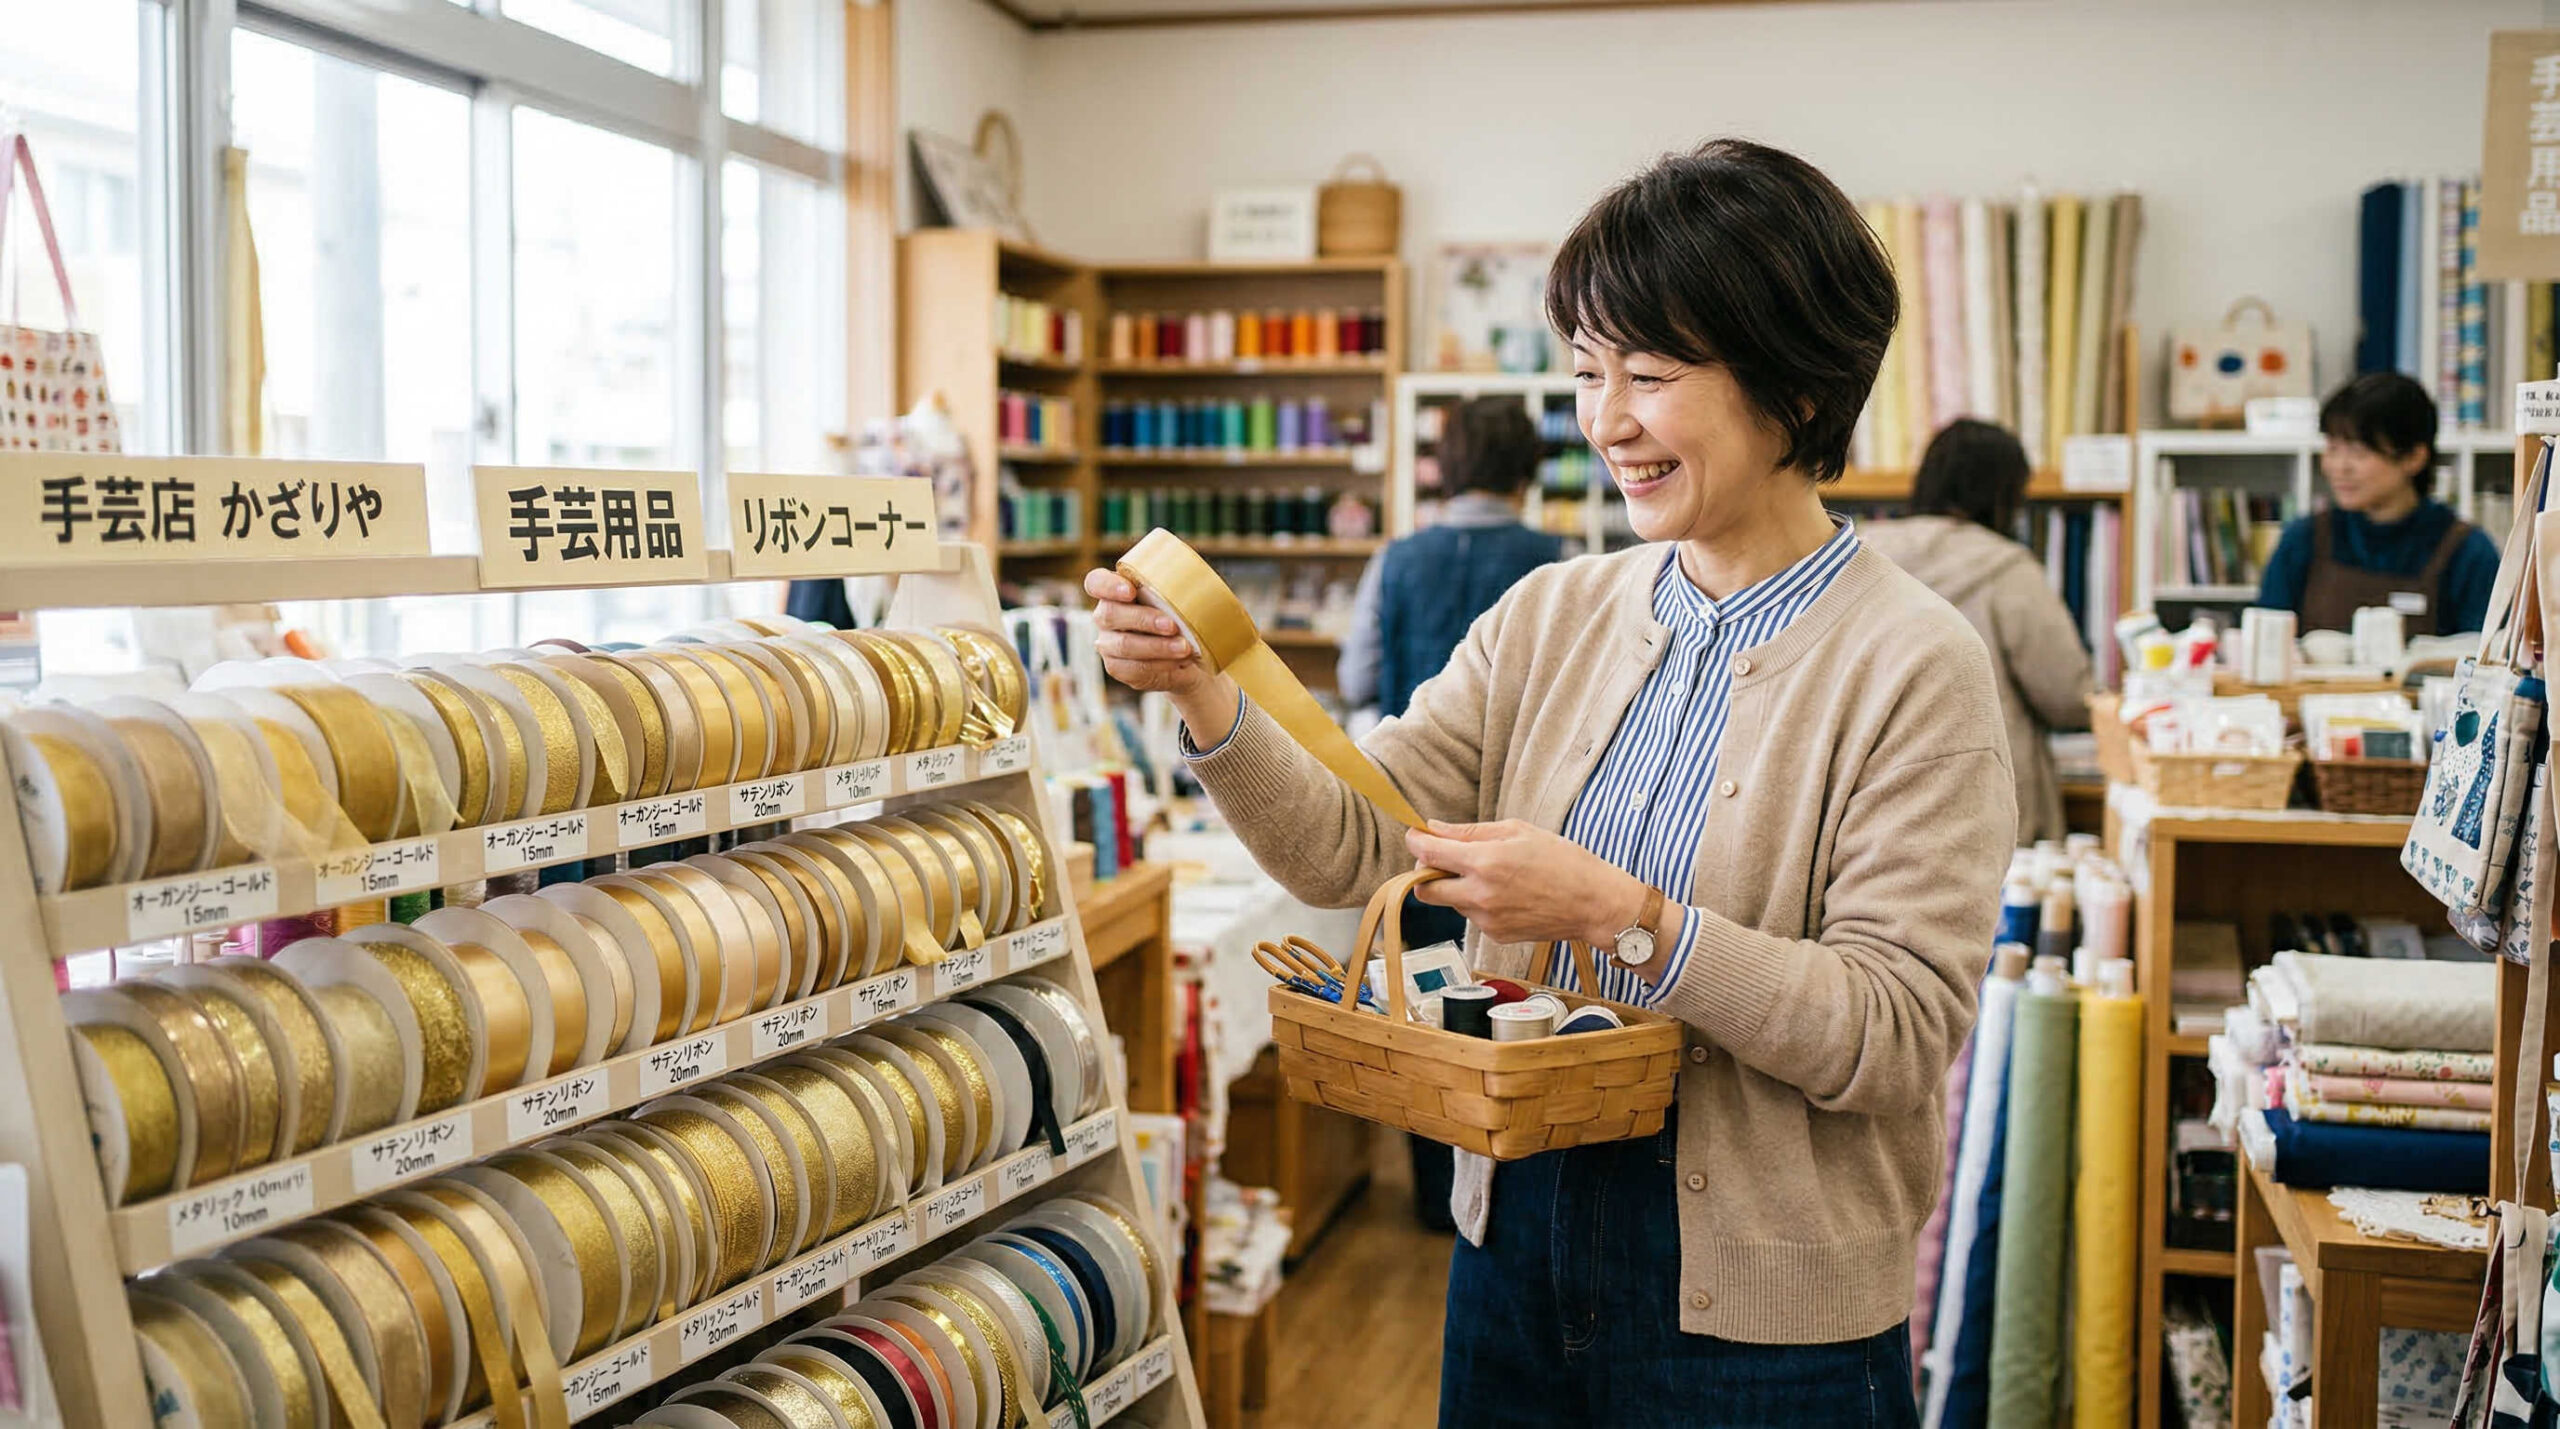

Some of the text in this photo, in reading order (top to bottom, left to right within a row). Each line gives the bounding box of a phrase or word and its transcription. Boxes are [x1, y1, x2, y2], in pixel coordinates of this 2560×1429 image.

[41, 477, 383, 544] 手芸店 かざりや
[509, 486, 685, 563] 手芸用品
[743, 497, 928, 556] リボンコーナー
[739, 780, 794, 803] サテンリボン
[619, 796, 703, 826] オーガンジー・ゴールド
[754, 802, 781, 817] 20mm
[487, 818, 584, 849] オーガンジー・ゴールド
[648, 822, 677, 838] 15mm
[521, 845, 554, 862] 15mm
[132, 869, 272, 912] オーガンジー・ゴールド
[361, 873, 399, 892] 15mm
[184, 904, 229, 926] 15mm
[761, 1005, 818, 1035] サテンリボン
[778, 1029, 805, 1048] 20mm
[650, 1039, 714, 1071] サテンリボン
[669, 1063, 700, 1084] 20mm
[521, 1078, 595, 1114] サテンリボン
[543, 1103, 578, 1127] 20mm
[370, 1123, 455, 1161] サテンリボン
[395, 1151, 435, 1176] 20mm
[176, 1188, 244, 1226] メタリック
[223, 1207, 269, 1232] 10mm
[708, 1321, 738, 1345] 20mm
[586, 1382, 621, 1406] 15mm
